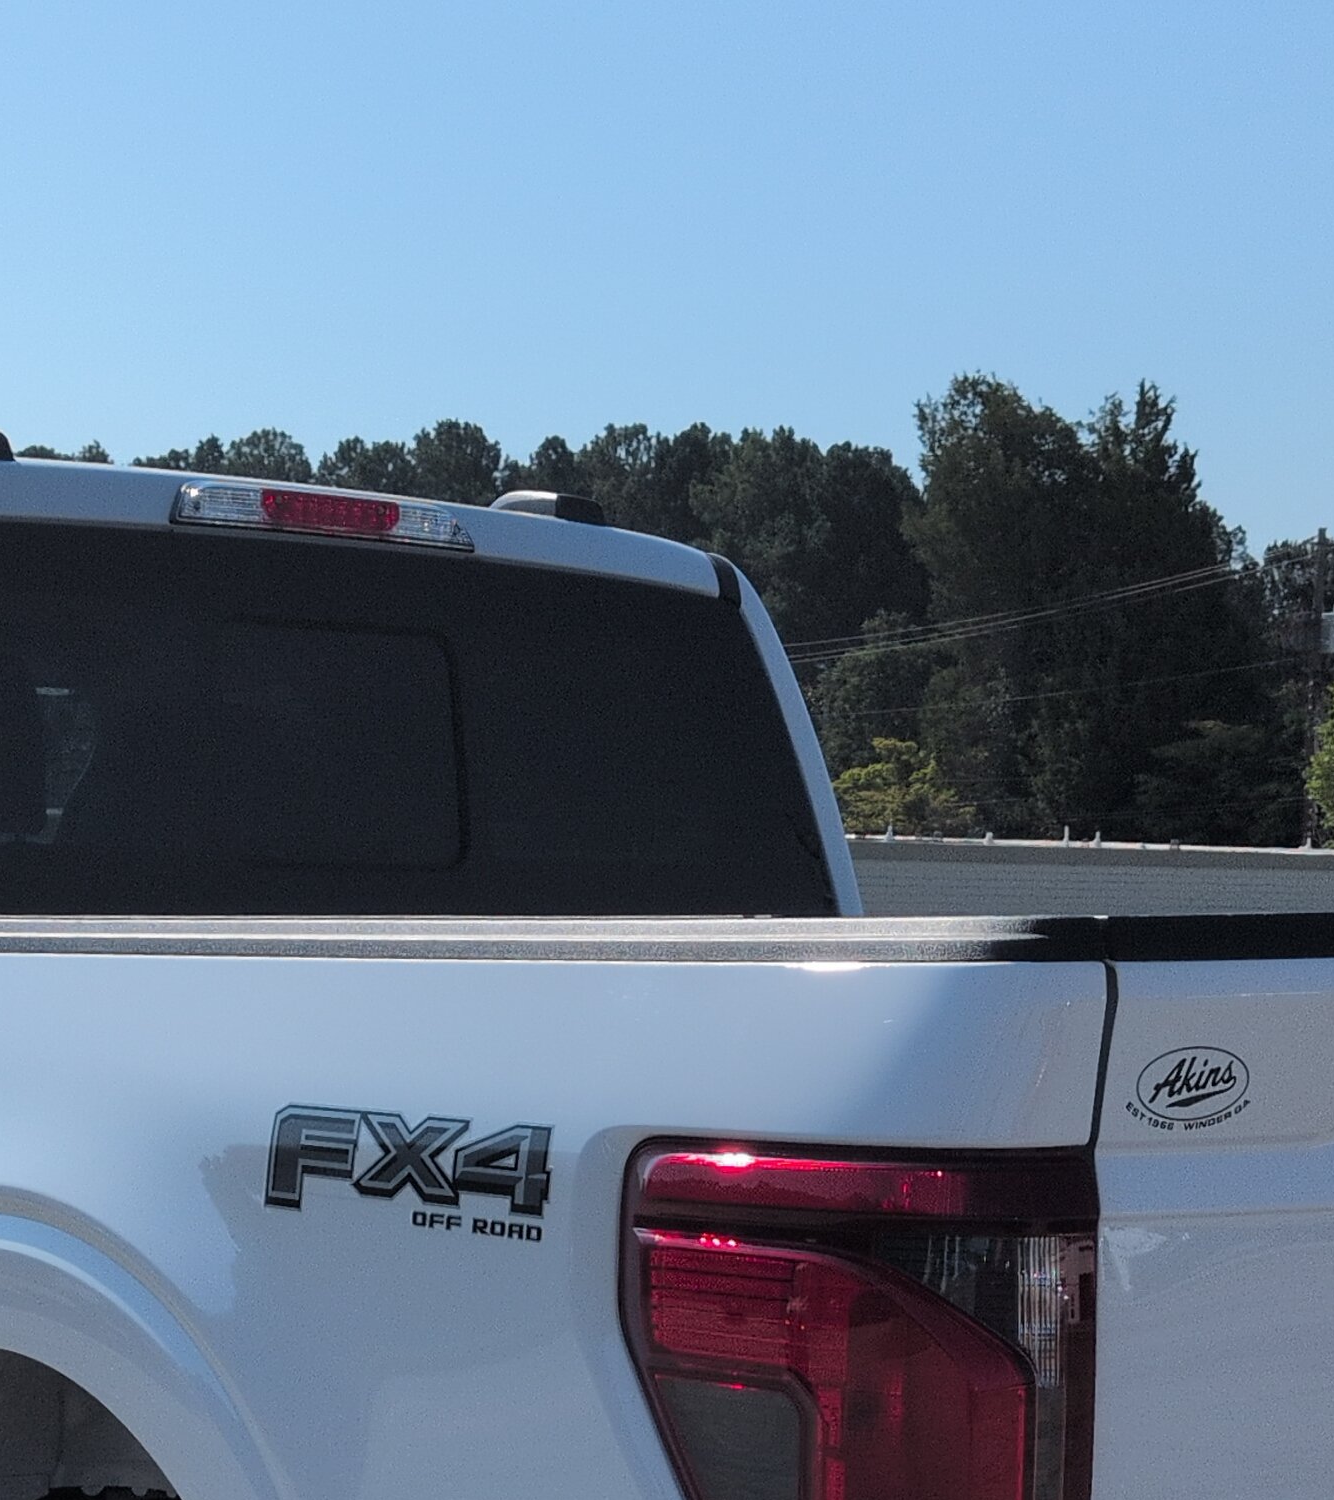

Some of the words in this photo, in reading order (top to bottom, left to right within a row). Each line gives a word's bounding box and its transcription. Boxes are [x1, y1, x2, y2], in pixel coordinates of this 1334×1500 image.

[1148, 1056, 1237, 1104] Akins
[1126, 1101, 1146, 1120] EST
[1184, 1111, 1232, 1130] WINDER
[264, 1104, 552, 1217] FX4
[411, 1210, 461, 1231] OFF
[471, 1217, 542, 1242] ROAD
